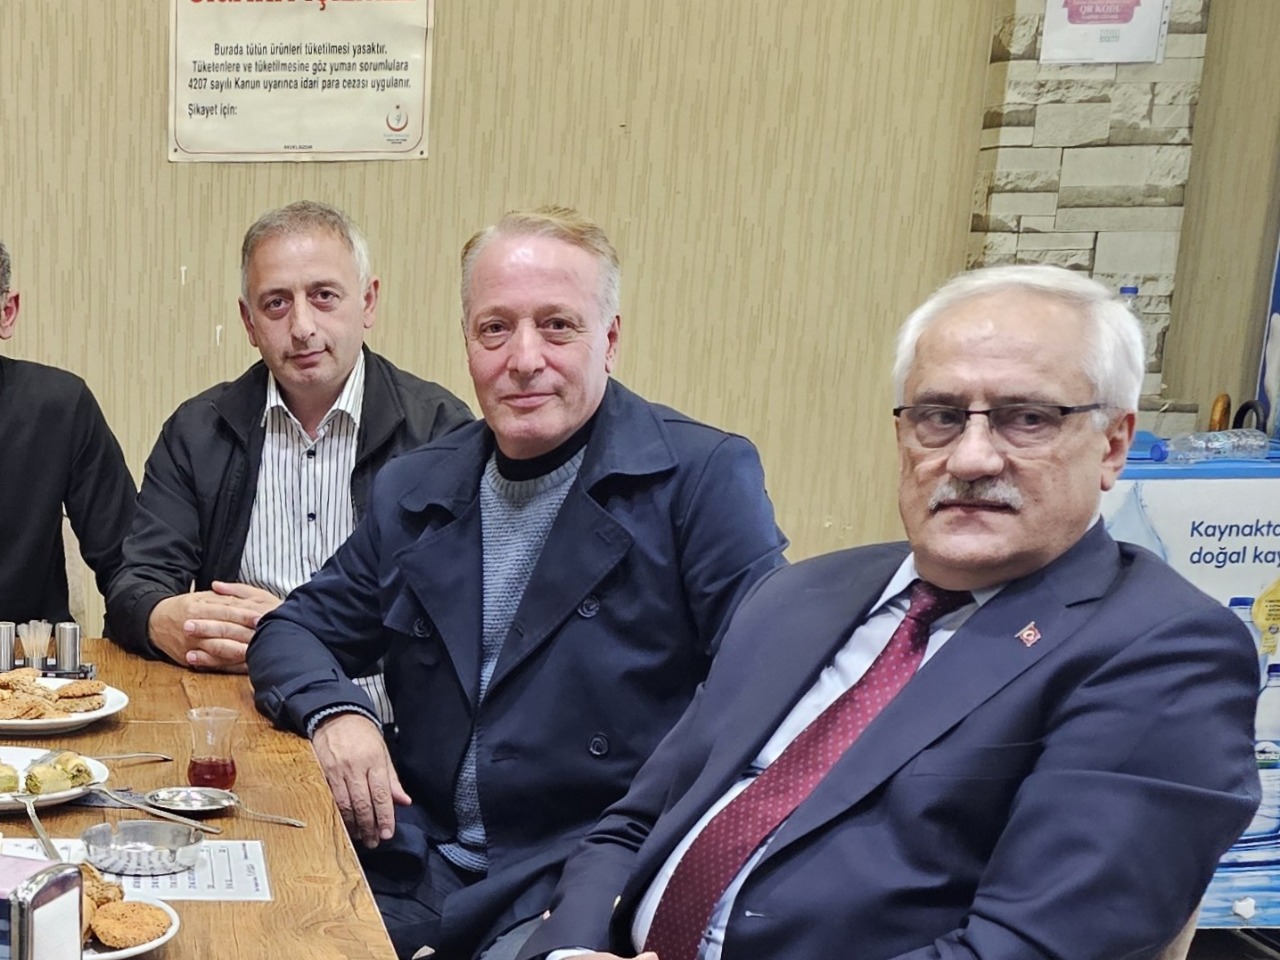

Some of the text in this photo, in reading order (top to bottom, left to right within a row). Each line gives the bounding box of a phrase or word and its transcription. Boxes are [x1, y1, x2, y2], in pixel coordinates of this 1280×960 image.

[214, 42, 387, 57] Burada tütün ürünleri tüketilmesi yasaktır.
[192, 59, 409, 75] Tüketenlere ve tüketilmesine göz yuman sorumlulara
[188, 77, 412, 93] 4207 sayılı Kanun uyarınca idari para cezası uygulanır.
[188, 103, 238, 118] Şikayet için:
[1189, 546, 1247, 569] doğal
